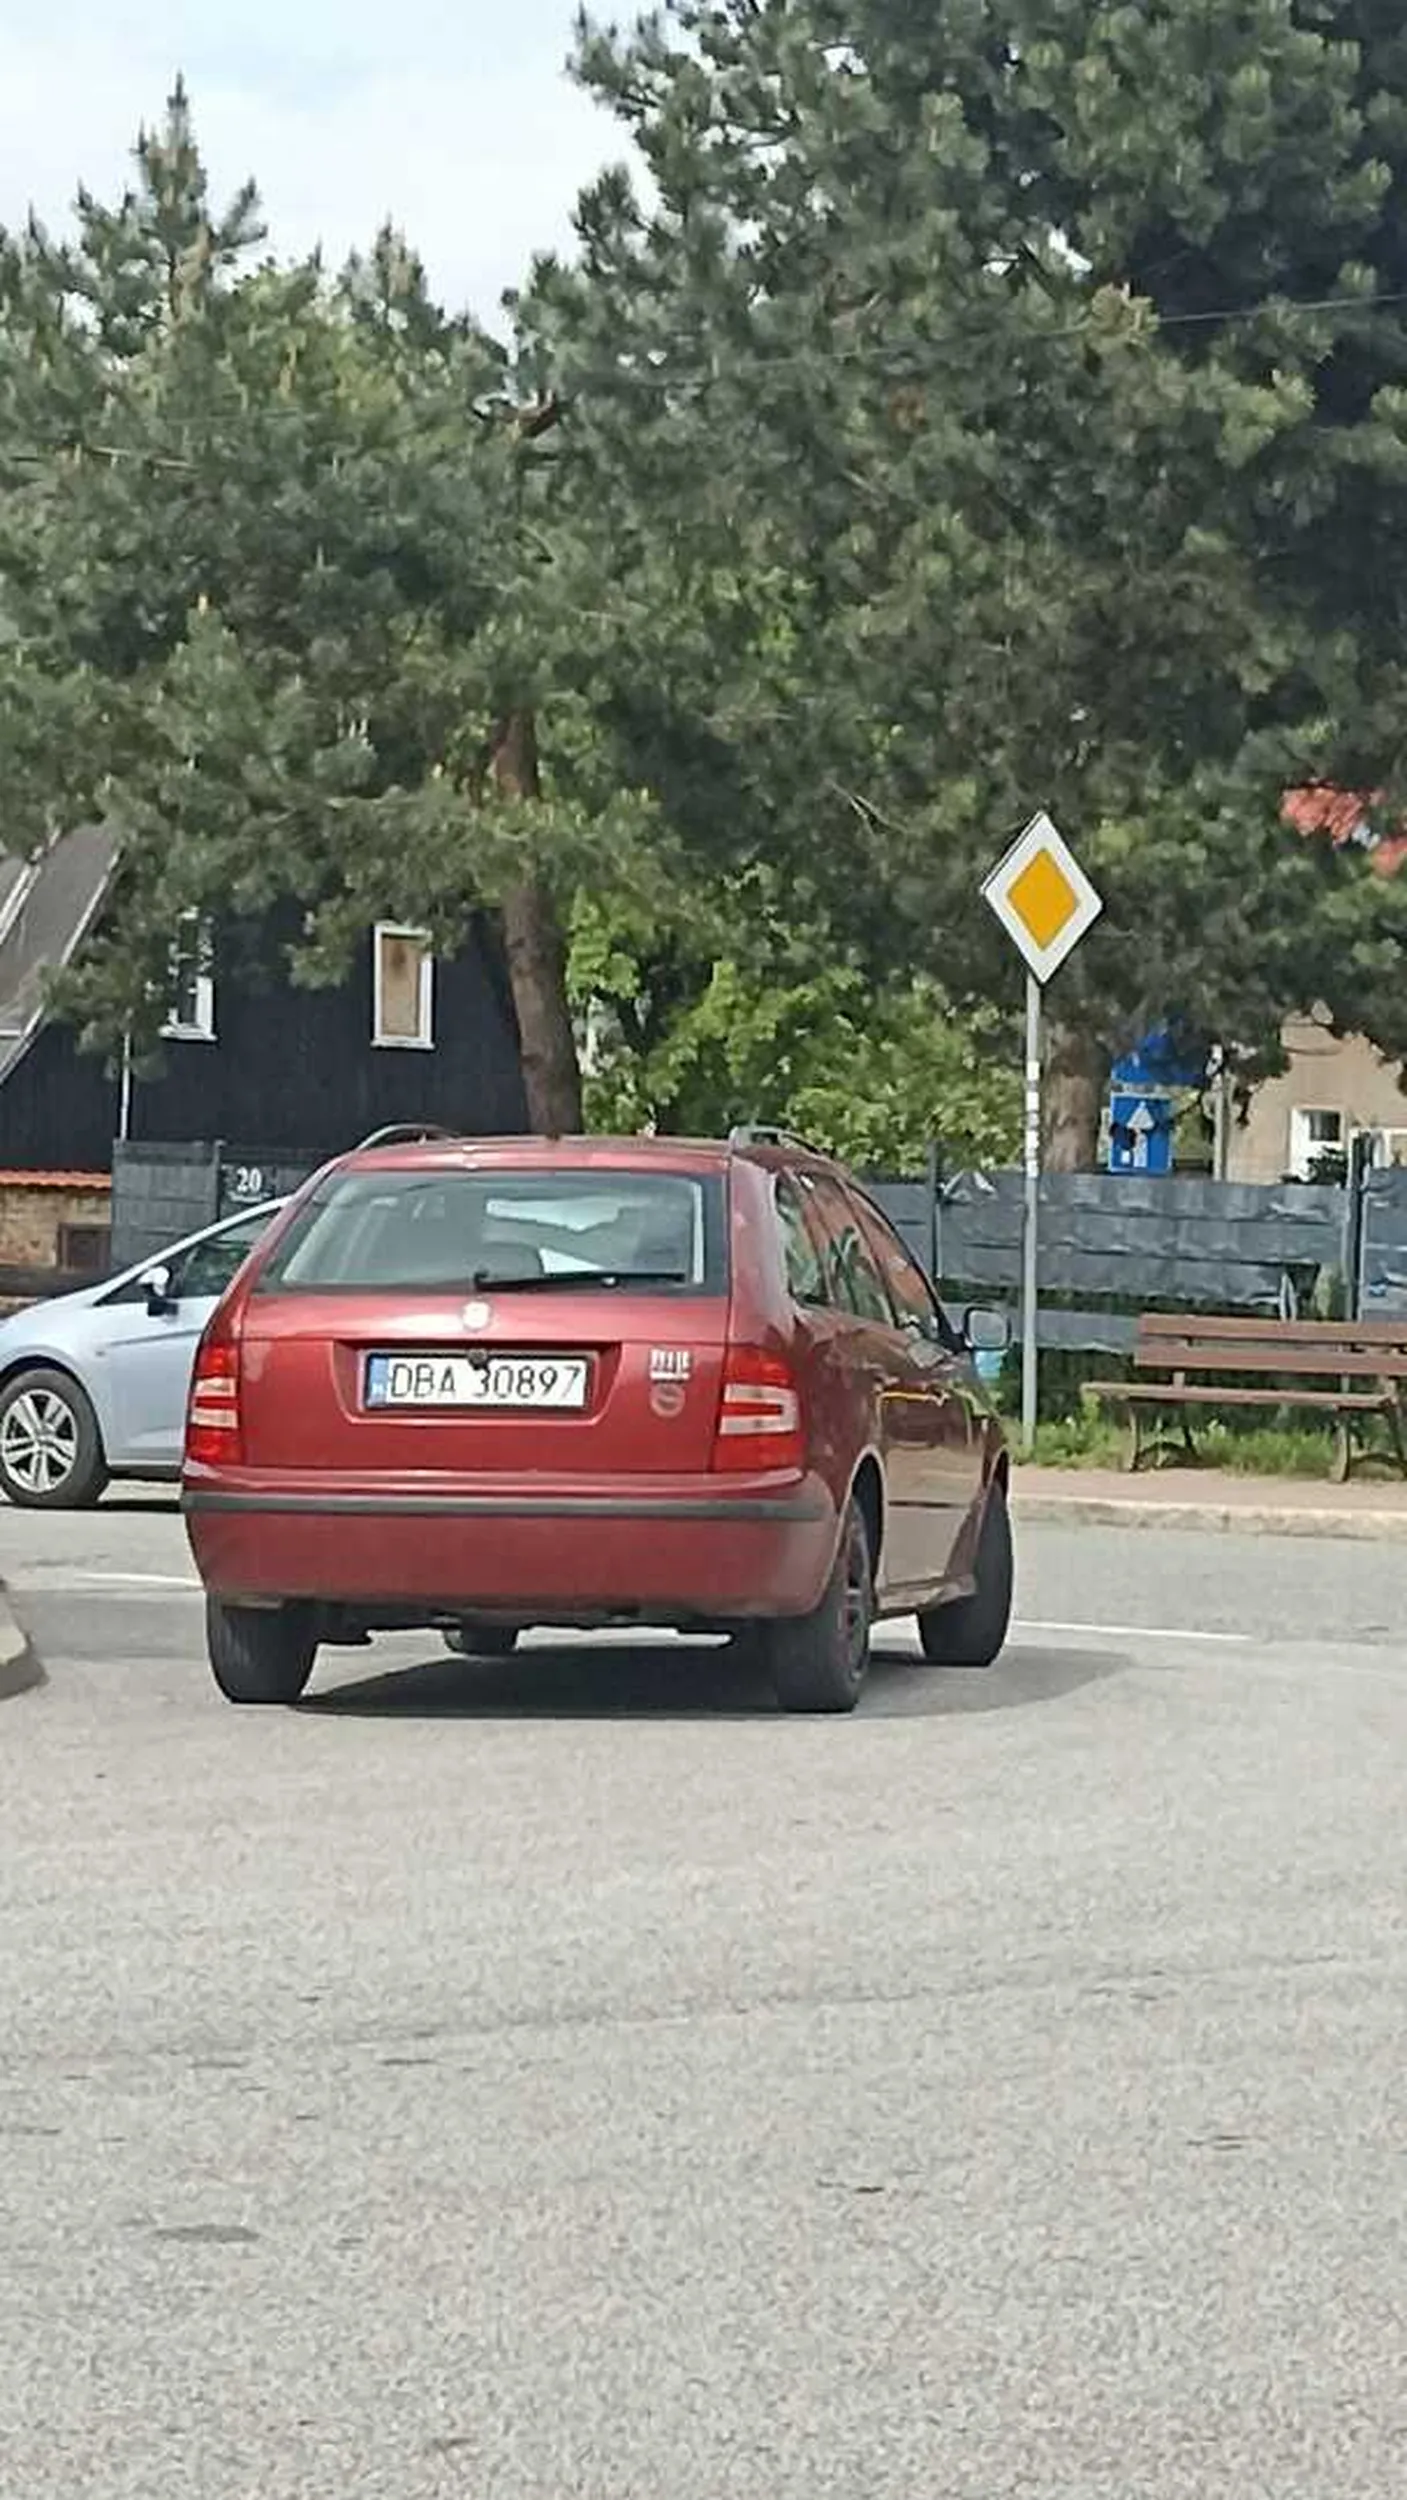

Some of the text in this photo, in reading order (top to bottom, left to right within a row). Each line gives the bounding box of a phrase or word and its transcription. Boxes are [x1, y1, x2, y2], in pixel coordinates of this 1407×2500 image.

[236, 1166, 262, 1192] 20
[391, 1363, 456, 1398] DBA
[472, 1364, 582, 1399] 30897
